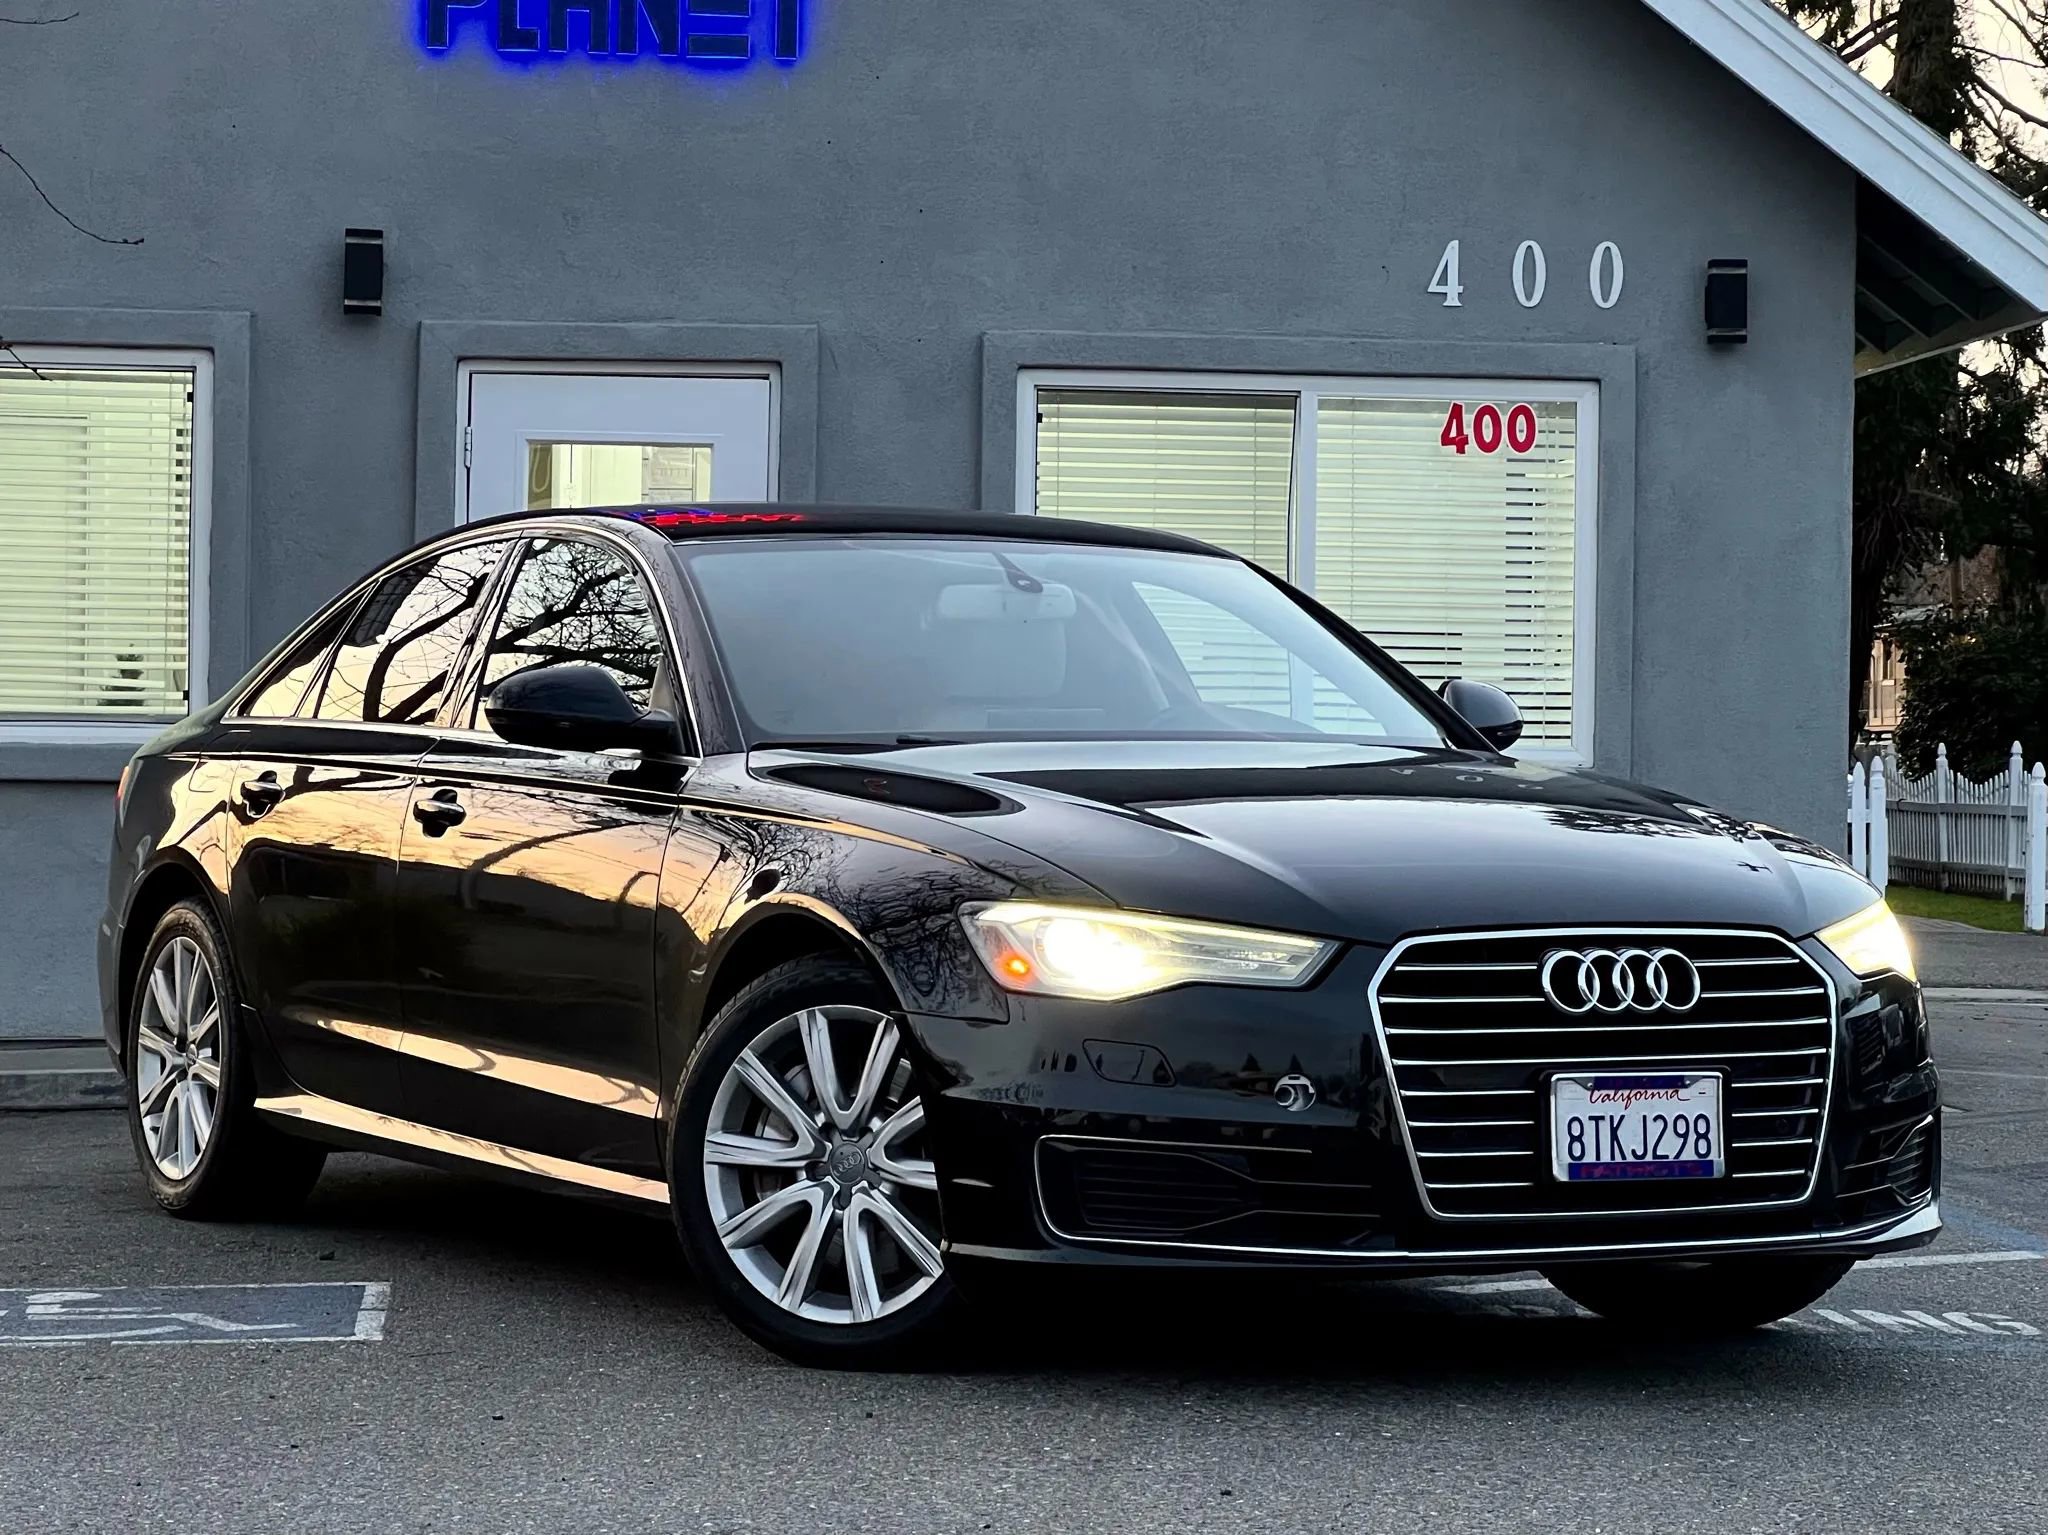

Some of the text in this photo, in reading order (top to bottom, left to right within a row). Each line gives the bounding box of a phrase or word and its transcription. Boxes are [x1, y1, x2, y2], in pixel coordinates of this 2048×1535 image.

[1440, 402, 1537, 454] 400
[1590, 1088, 1690, 1110] California
[1567, 1113, 1712, 1162] 8TKJ298
